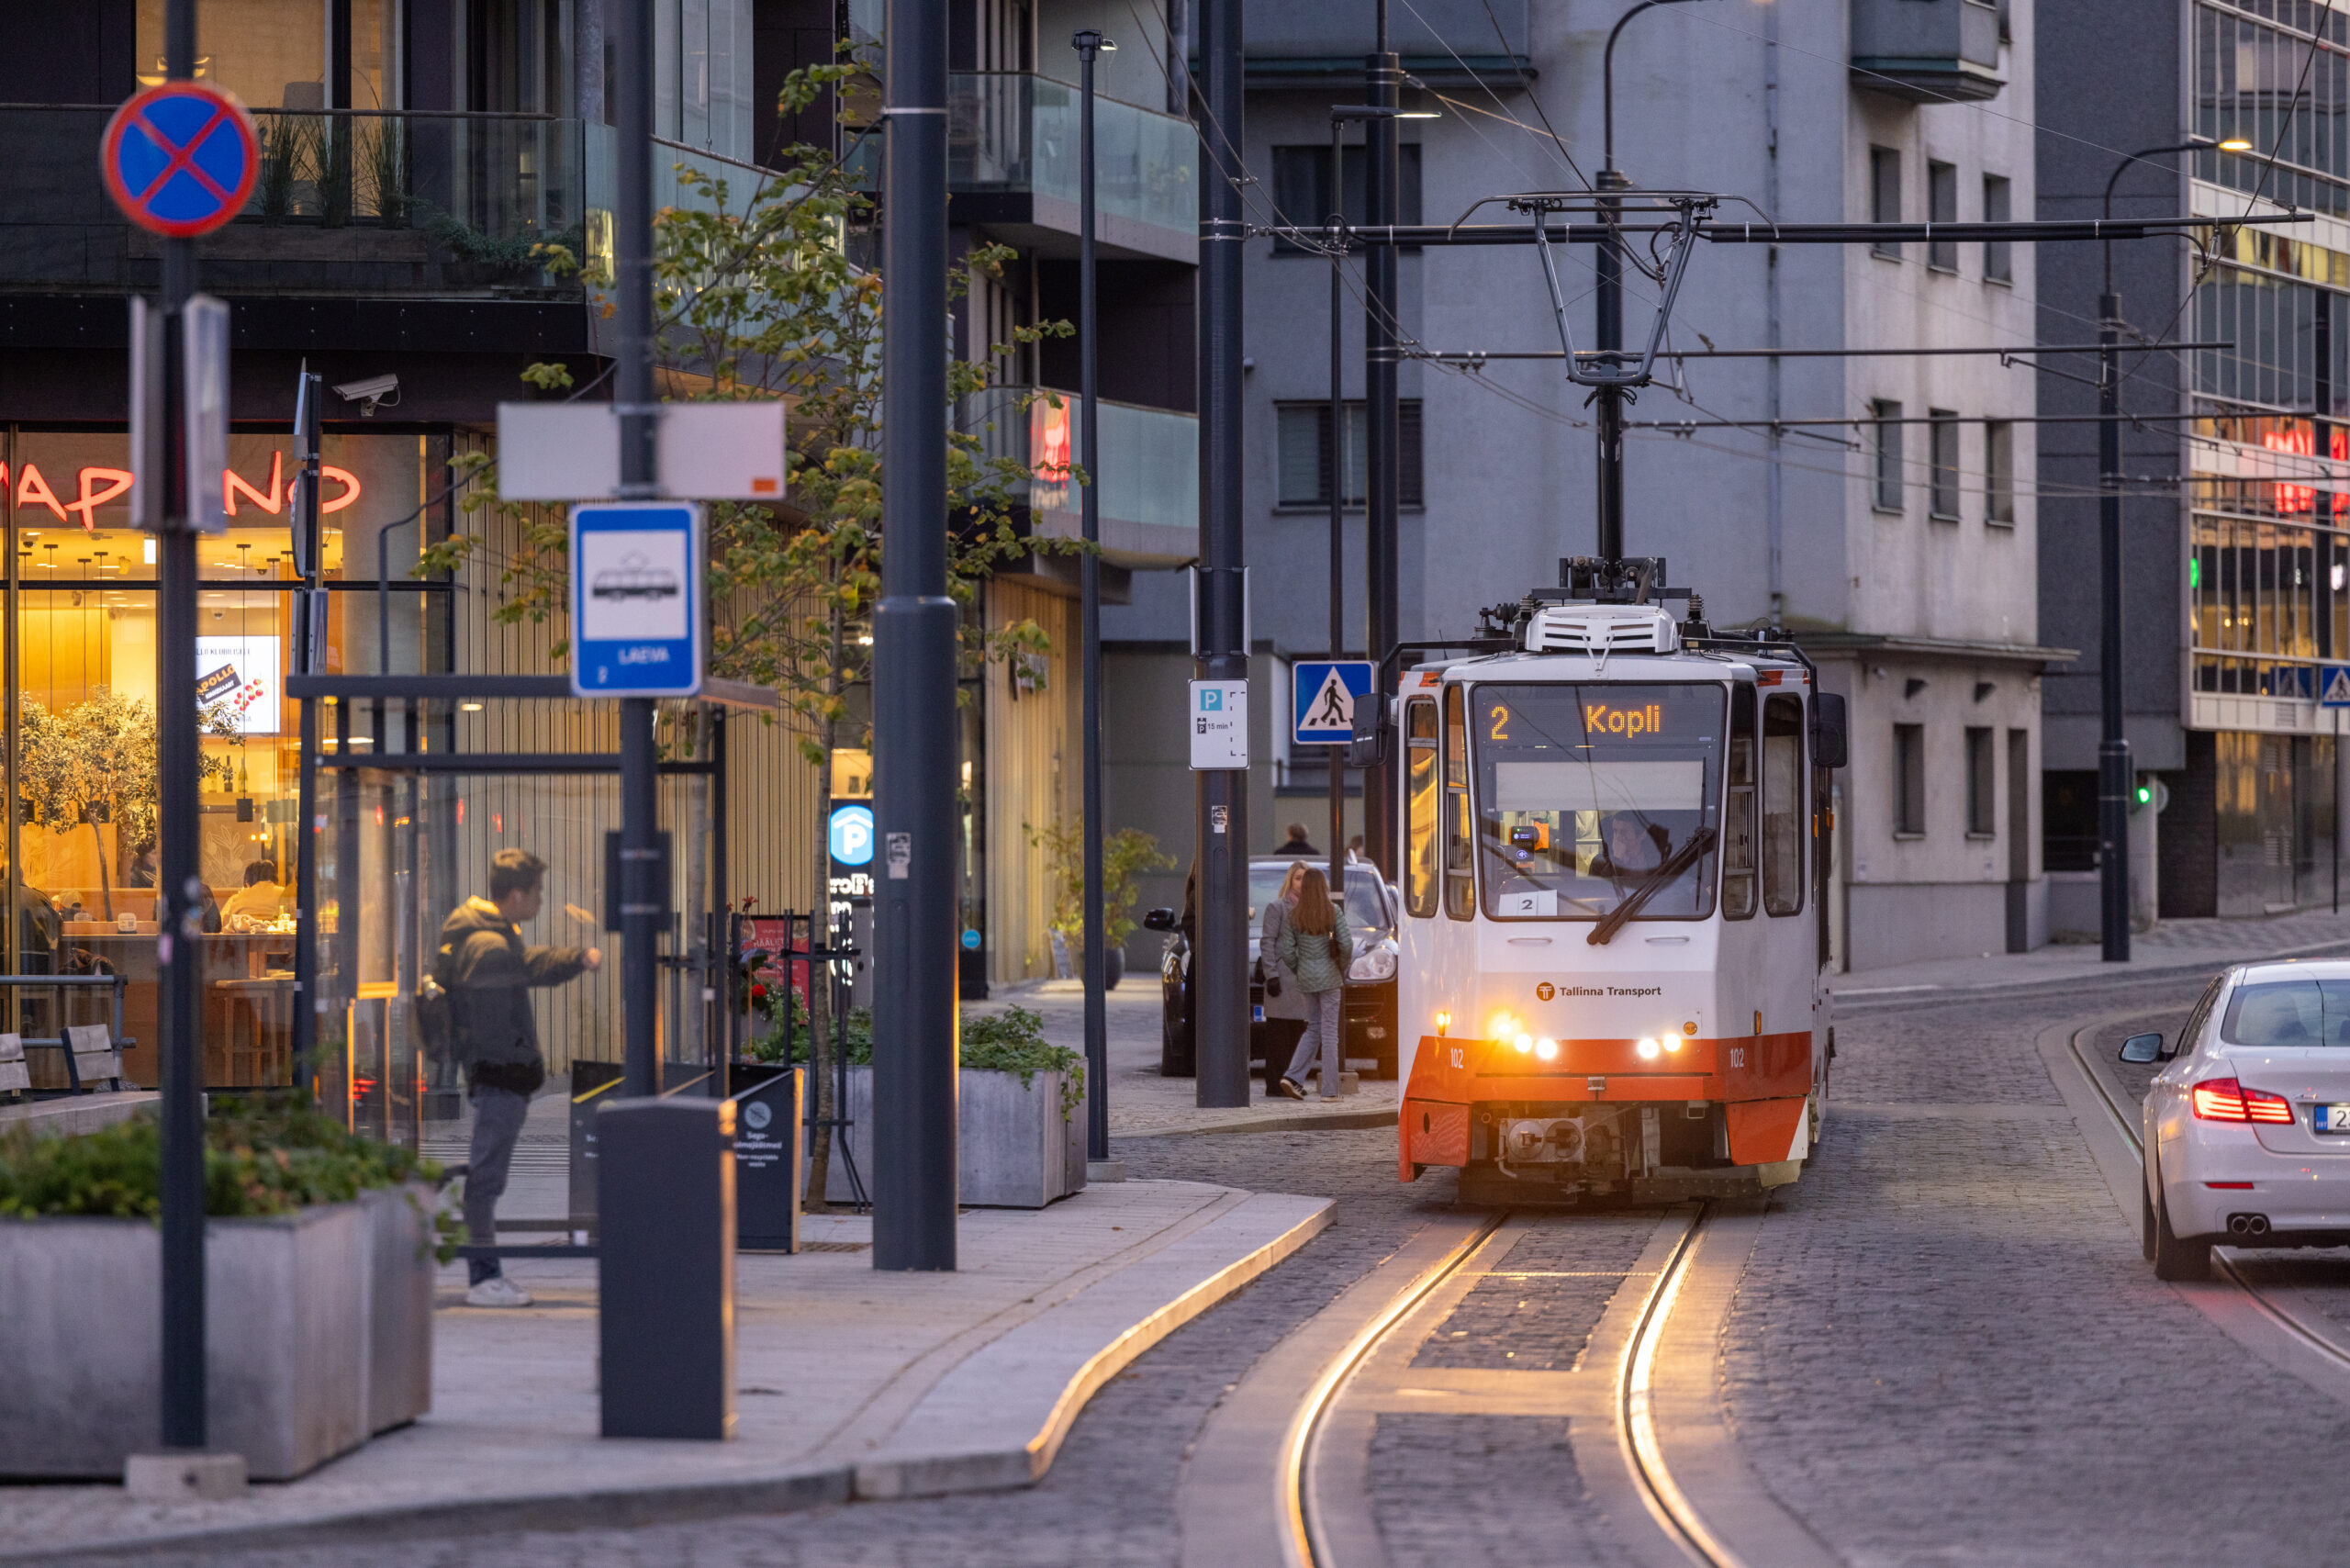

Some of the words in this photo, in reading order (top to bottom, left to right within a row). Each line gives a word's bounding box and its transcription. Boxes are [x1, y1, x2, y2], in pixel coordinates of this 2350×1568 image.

[0, 451, 361, 532] APNO
[1205, 691, 1217, 709] P
[1491, 706, 1508, 739] 2
[1587, 705, 1660, 738] Kopli
[844, 824, 867, 855] P
[1521, 900, 1533, 910] 2
[1560, 987, 1604, 996] Tallinna
[1606, 987, 1662, 997] Transport
[1450, 1047, 1464, 1069] 102
[1730, 1047, 1744, 1068] 102
[2336, 1110, 2350, 1127] 2
